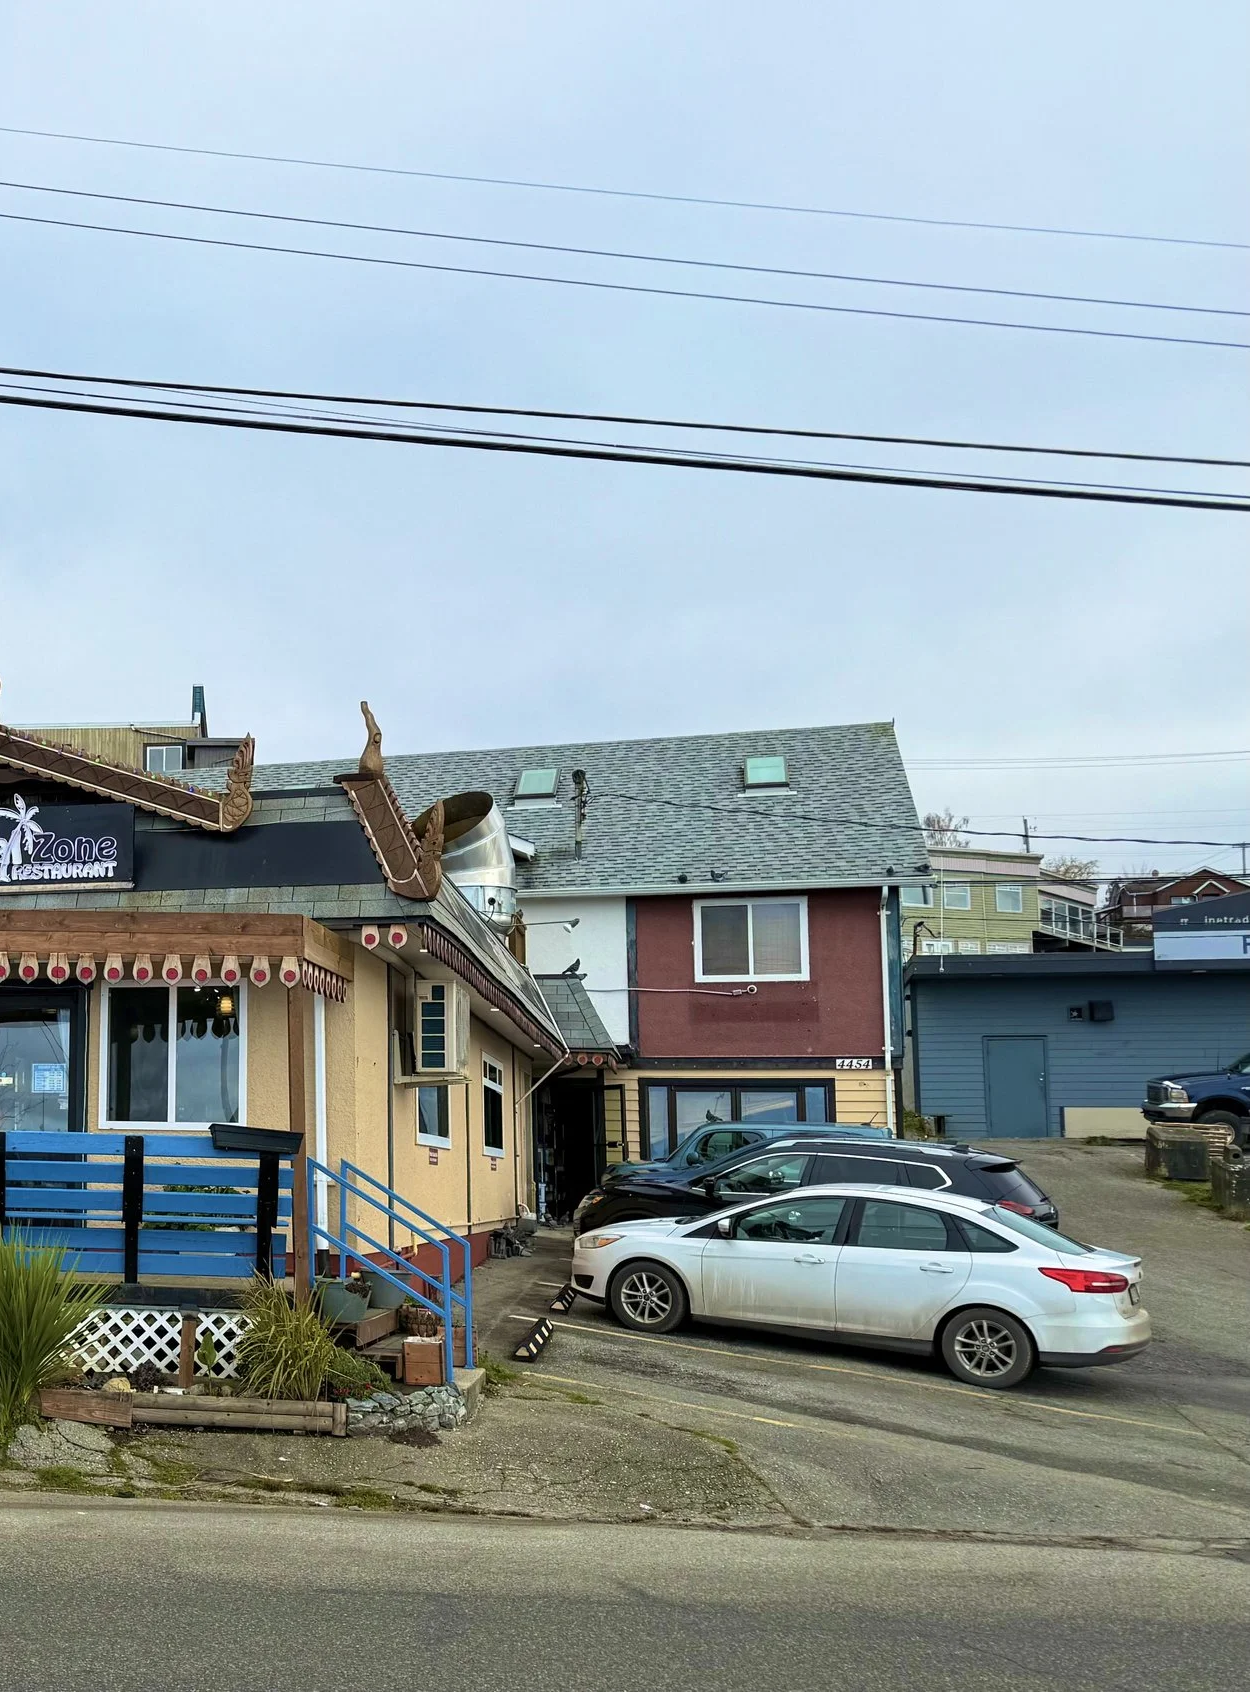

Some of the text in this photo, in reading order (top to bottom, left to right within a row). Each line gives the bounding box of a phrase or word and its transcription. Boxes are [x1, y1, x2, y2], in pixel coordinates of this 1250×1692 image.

[31, 831, 118, 863] Zone
[11, 860, 117, 881] RESTAURANT
[837, 1059, 871, 1069] 4454
